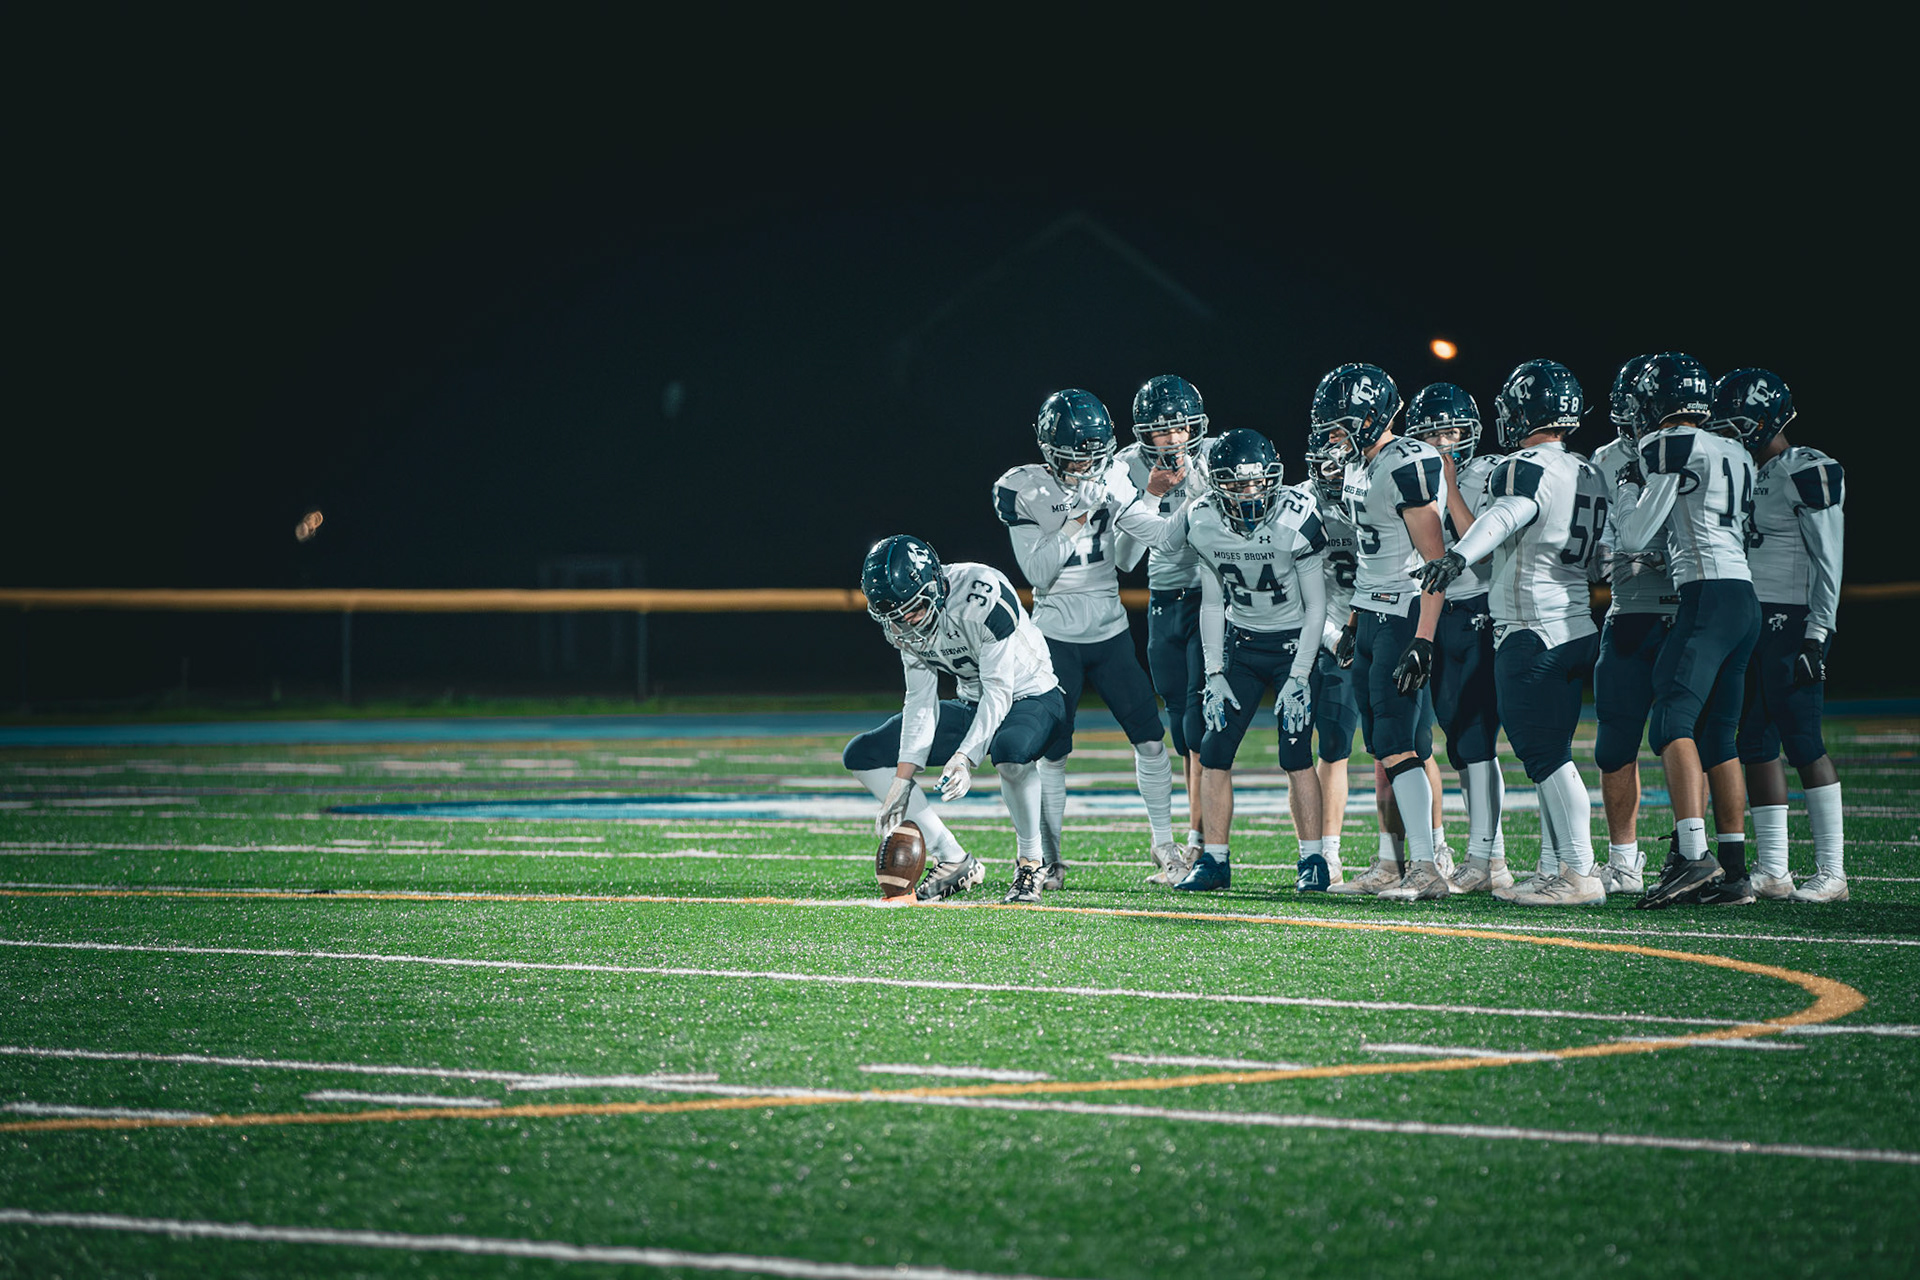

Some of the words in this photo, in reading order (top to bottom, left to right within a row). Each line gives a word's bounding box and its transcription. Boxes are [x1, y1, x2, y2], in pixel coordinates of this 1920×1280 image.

[1694, 377, 1707, 395] 14
[1559, 395, 1579, 413] 58
[1395, 440, 1422, 459] 15
[1052, 502, 1073, 513] MOS
[1283, 489, 1309, 514] 24
[1213, 551, 1240, 560] MOSES
[1244, 552, 1275, 560] BROWN
[967, 579, 993, 607] 33
[1218, 563, 1287, 607] 24
